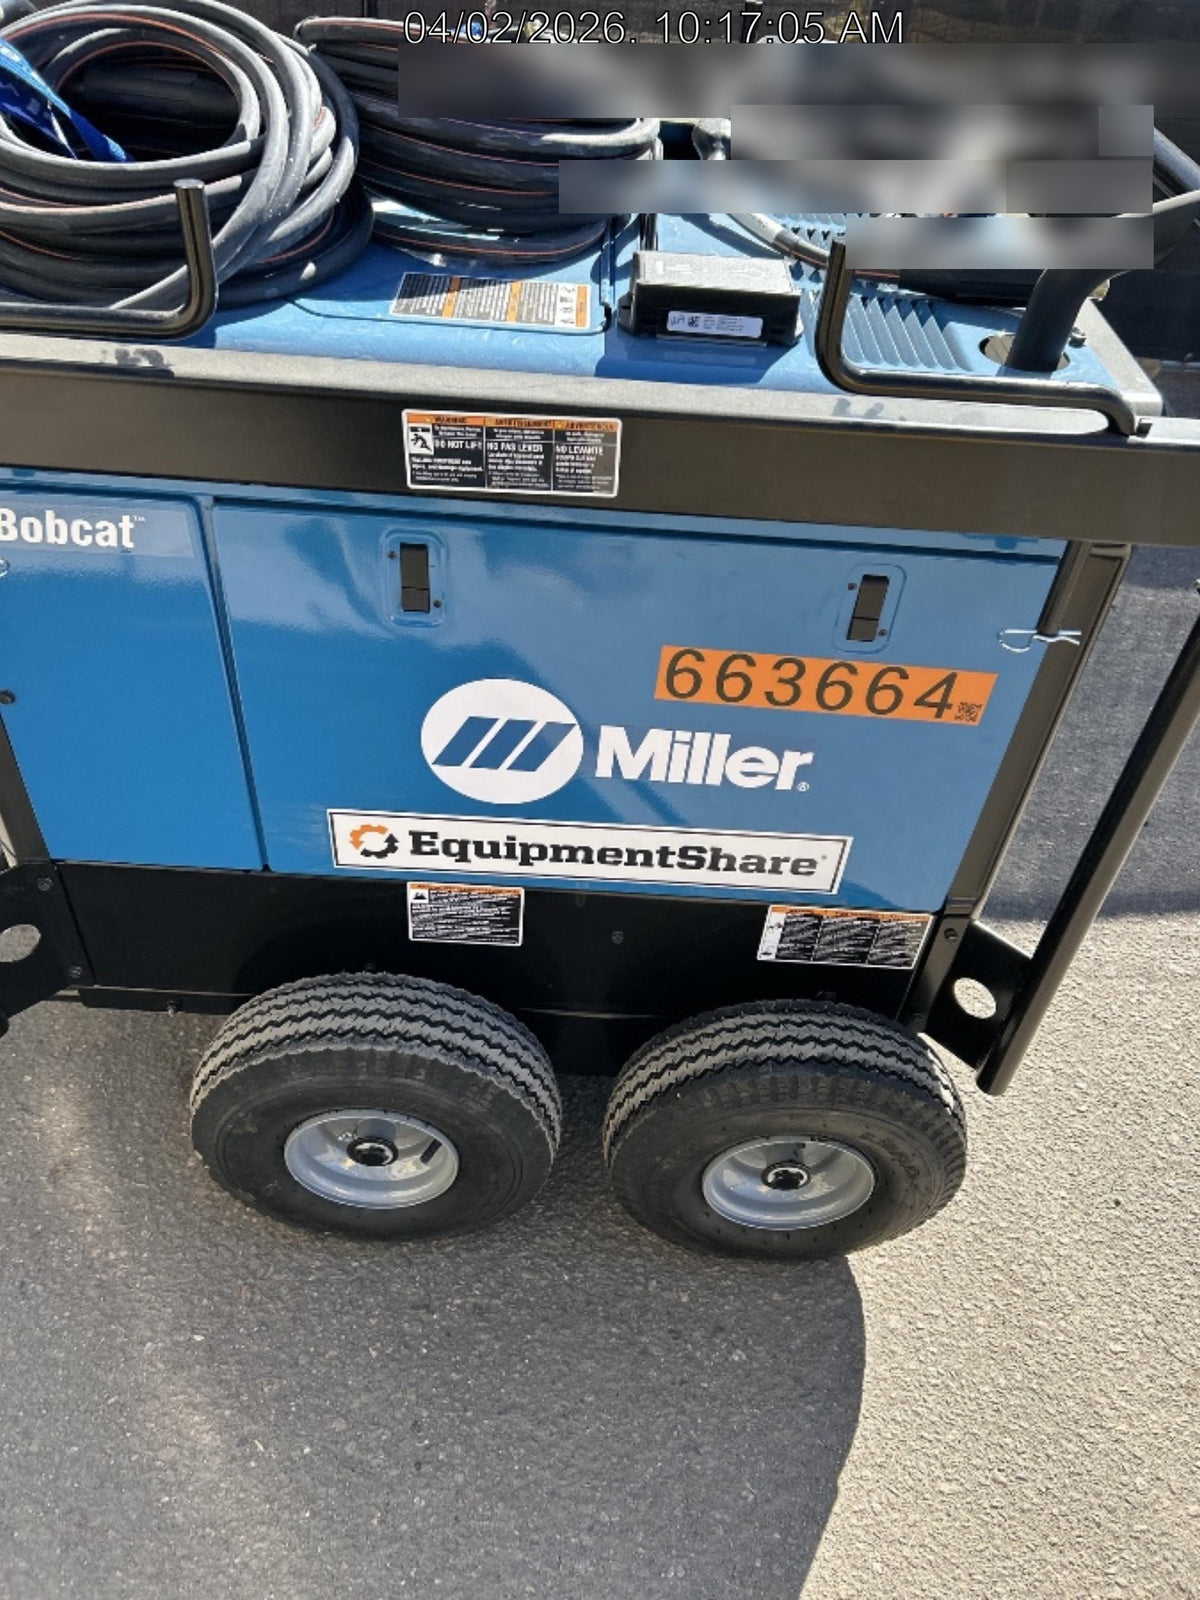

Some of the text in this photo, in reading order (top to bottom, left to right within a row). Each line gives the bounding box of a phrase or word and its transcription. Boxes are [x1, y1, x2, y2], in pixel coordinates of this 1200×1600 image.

[447, 440, 464, 449] NOT
[665, 648, 959, 719] 663664
[408, 829, 820, 876] EquipmentShare
